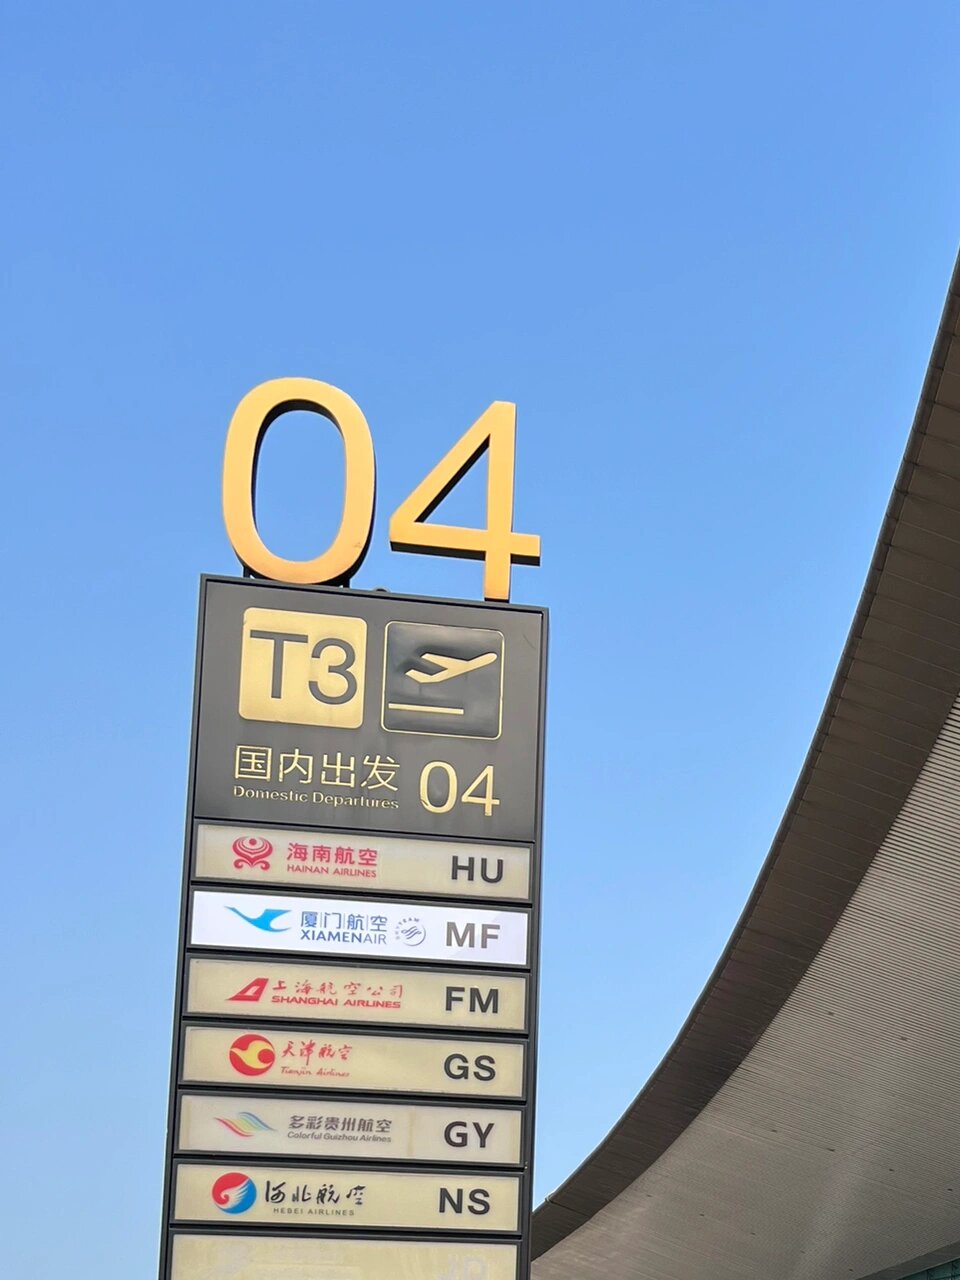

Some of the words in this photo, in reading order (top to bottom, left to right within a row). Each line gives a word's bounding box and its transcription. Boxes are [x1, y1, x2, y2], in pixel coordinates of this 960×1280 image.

[222, 377, 541, 601] 04
[249, 630, 357, 705] T3
[234, 744, 400, 792] 国内出发
[233, 785, 307, 803] Domestic
[312, 790, 400, 810] Departures
[419, 760, 500, 817] 04
[287, 842, 378, 867] 海南航空
[287, 864, 328, 876] HAINAN
[333, 866, 377, 878] AIRLINES
[450, 855, 504, 883] HU
[300, 911, 388, 932] 厦门航空
[300, 928, 387, 945] XIAMENAIR
[446, 921, 501, 949] MF
[272, 977, 403, 999] 上海航空公司
[445, 985, 499, 1014] FM
[272, 994, 338, 1007] SHANGHAI
[344, 998, 401, 1010] AIRLINES
[281, 1039, 353, 1066] 天津航空
[444, 1053, 496, 1082] GS
[288, 1114, 393, 1133] 多彩贵州航空
[444, 1120, 495, 1149] GY
[287, 1130, 322, 1141] Colorful
[323, 1132, 358, 1143] Guizhou
[359, 1134, 392, 1144] Airlines
[265, 1180, 366, 1206] 河北航空
[438, 1187, 491, 1216] NS
[273, 1207, 304, 1216] HEBEI
[307, 1208, 355, 1217] AIRLINES
